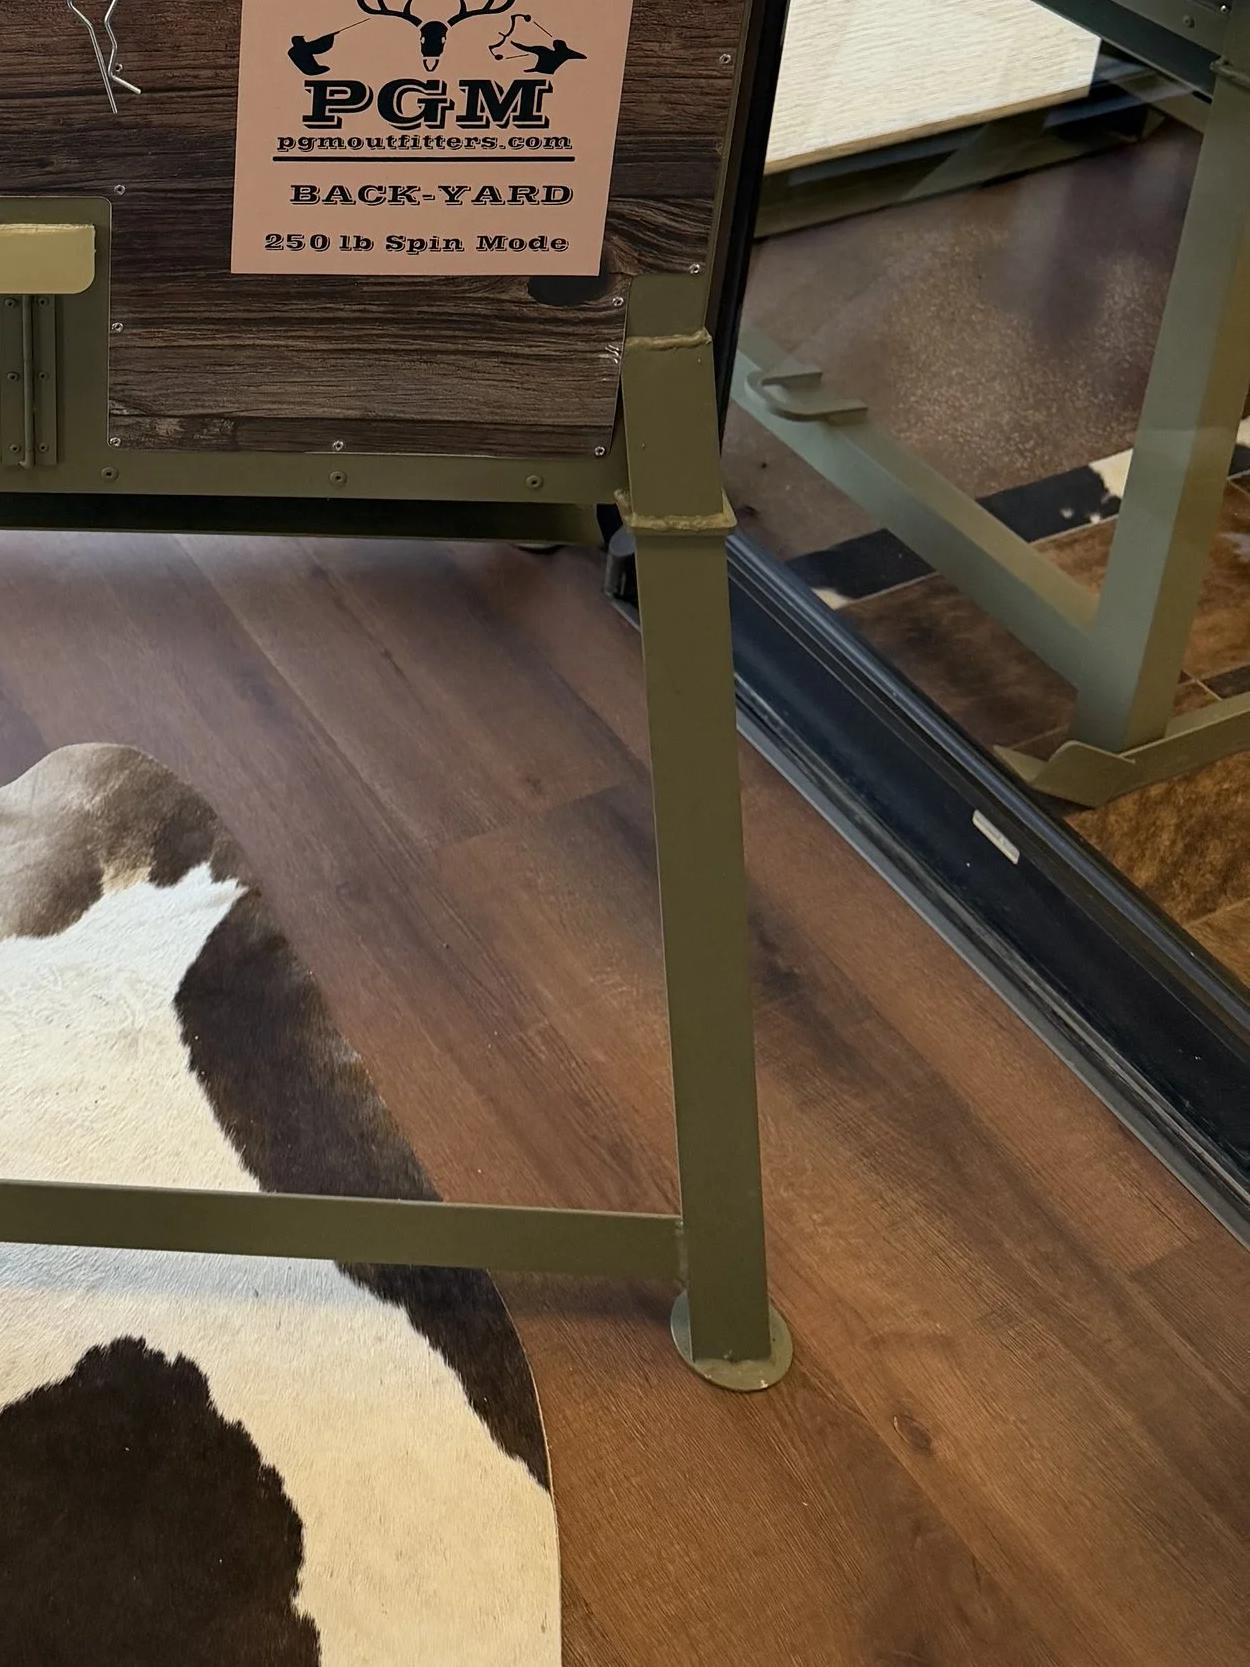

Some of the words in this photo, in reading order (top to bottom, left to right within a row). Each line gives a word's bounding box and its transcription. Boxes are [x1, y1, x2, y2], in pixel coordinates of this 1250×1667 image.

[302, 78, 554, 130] PGM
[276, 134, 573, 152] pgmoutfitters.com
[289, 184, 574, 206] BACK-YARD
[264, 233, 333, 252] 250
[338, 233, 375, 252] lb
[385, 234, 465, 255] Spin
[476, 234, 570, 253] Mode
